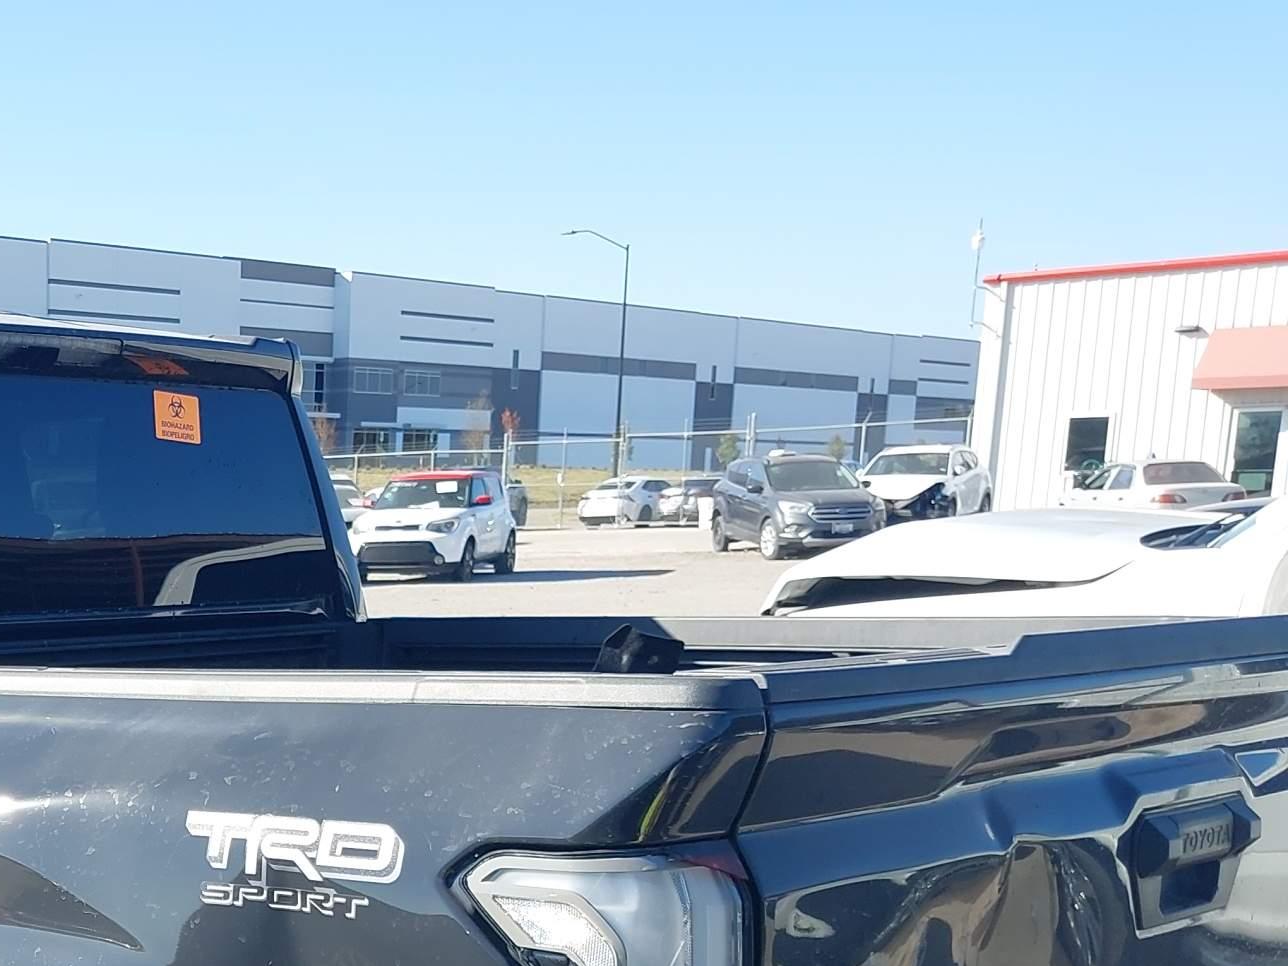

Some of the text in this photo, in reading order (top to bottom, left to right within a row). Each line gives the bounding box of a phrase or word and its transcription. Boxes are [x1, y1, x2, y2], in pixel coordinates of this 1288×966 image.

[161, 420, 194, 431] BIOHAZARD
[161, 430, 195, 441] BIOPELIGRO
[185, 810, 405, 884] TRD
[1182, 823, 1231, 854] TOYOTA
[200, 880, 370, 920] SPORT
